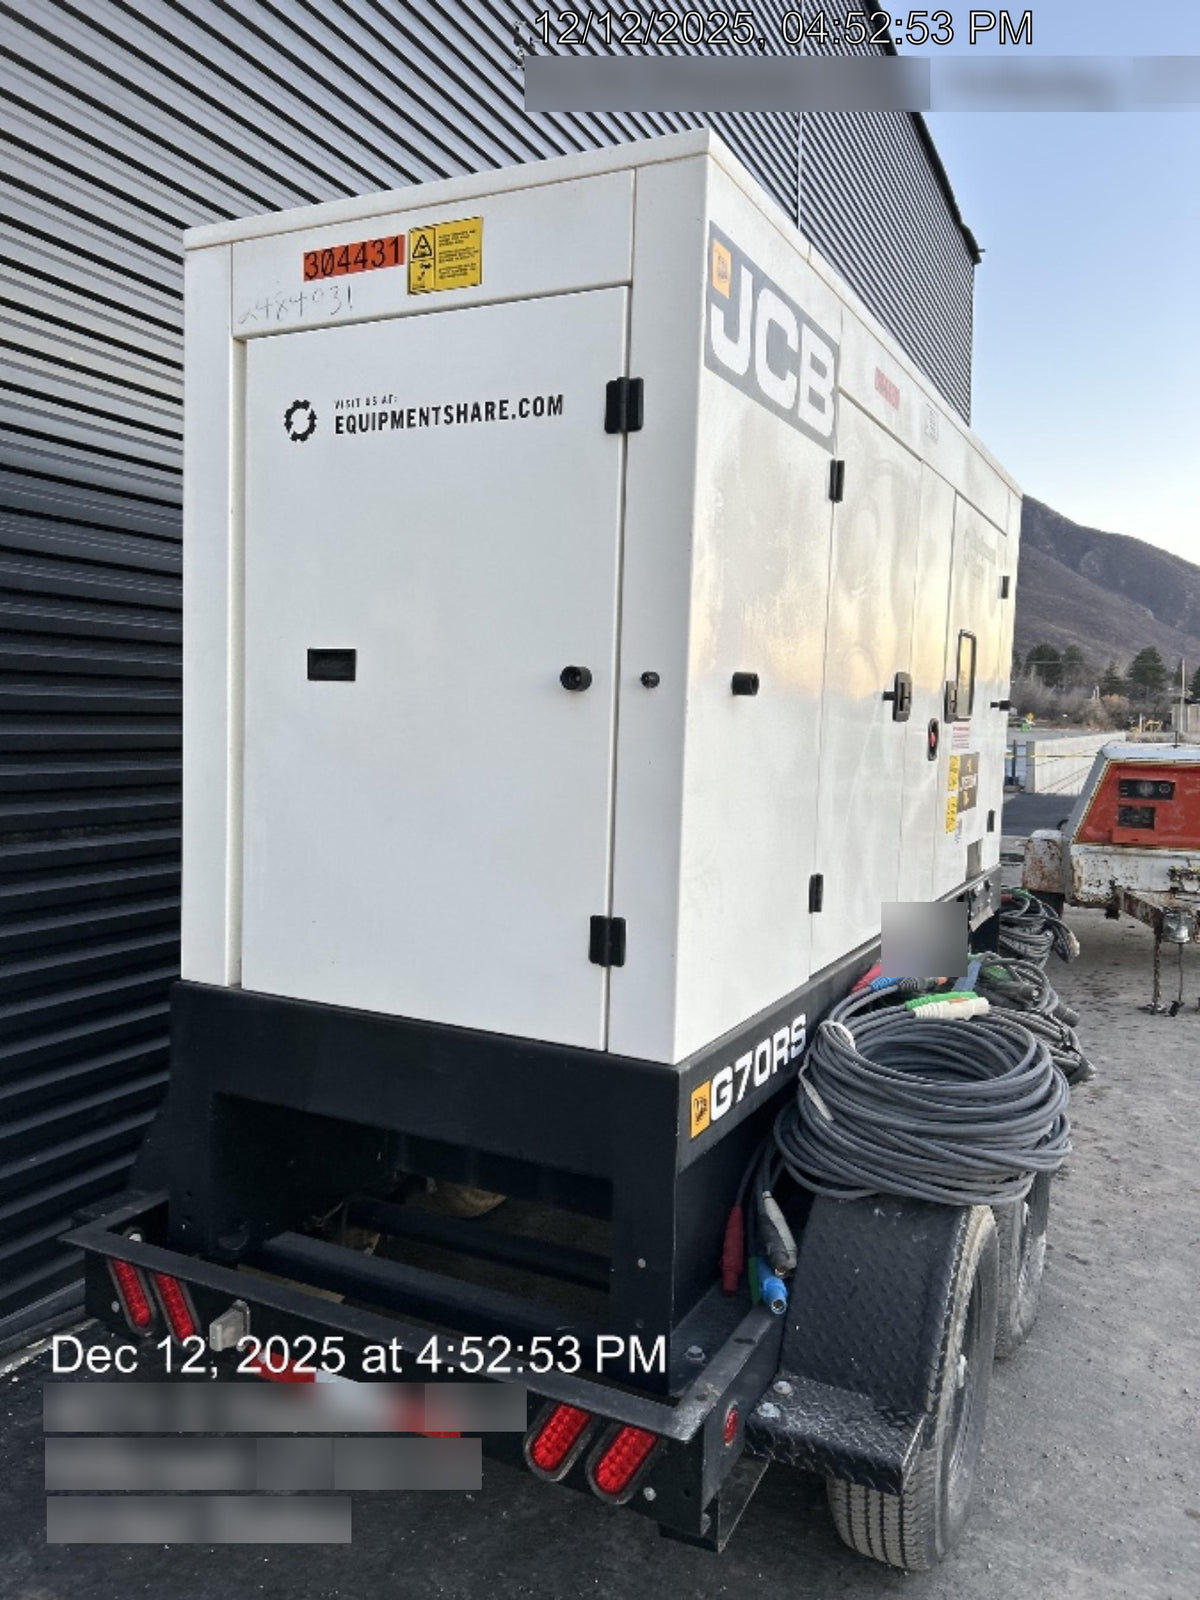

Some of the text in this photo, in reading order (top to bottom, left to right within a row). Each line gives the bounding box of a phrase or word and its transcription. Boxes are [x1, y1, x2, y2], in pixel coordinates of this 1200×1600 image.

[304, 236, 402, 279] 304431
[710, 263, 836, 438] JCB
[334, 397, 361, 409] VISIT
[366, 395, 378, 406] US
[335, 394, 564, 435] EQUIPMENTSHARE.COM
[711, 1013, 807, 1121] G70RS
